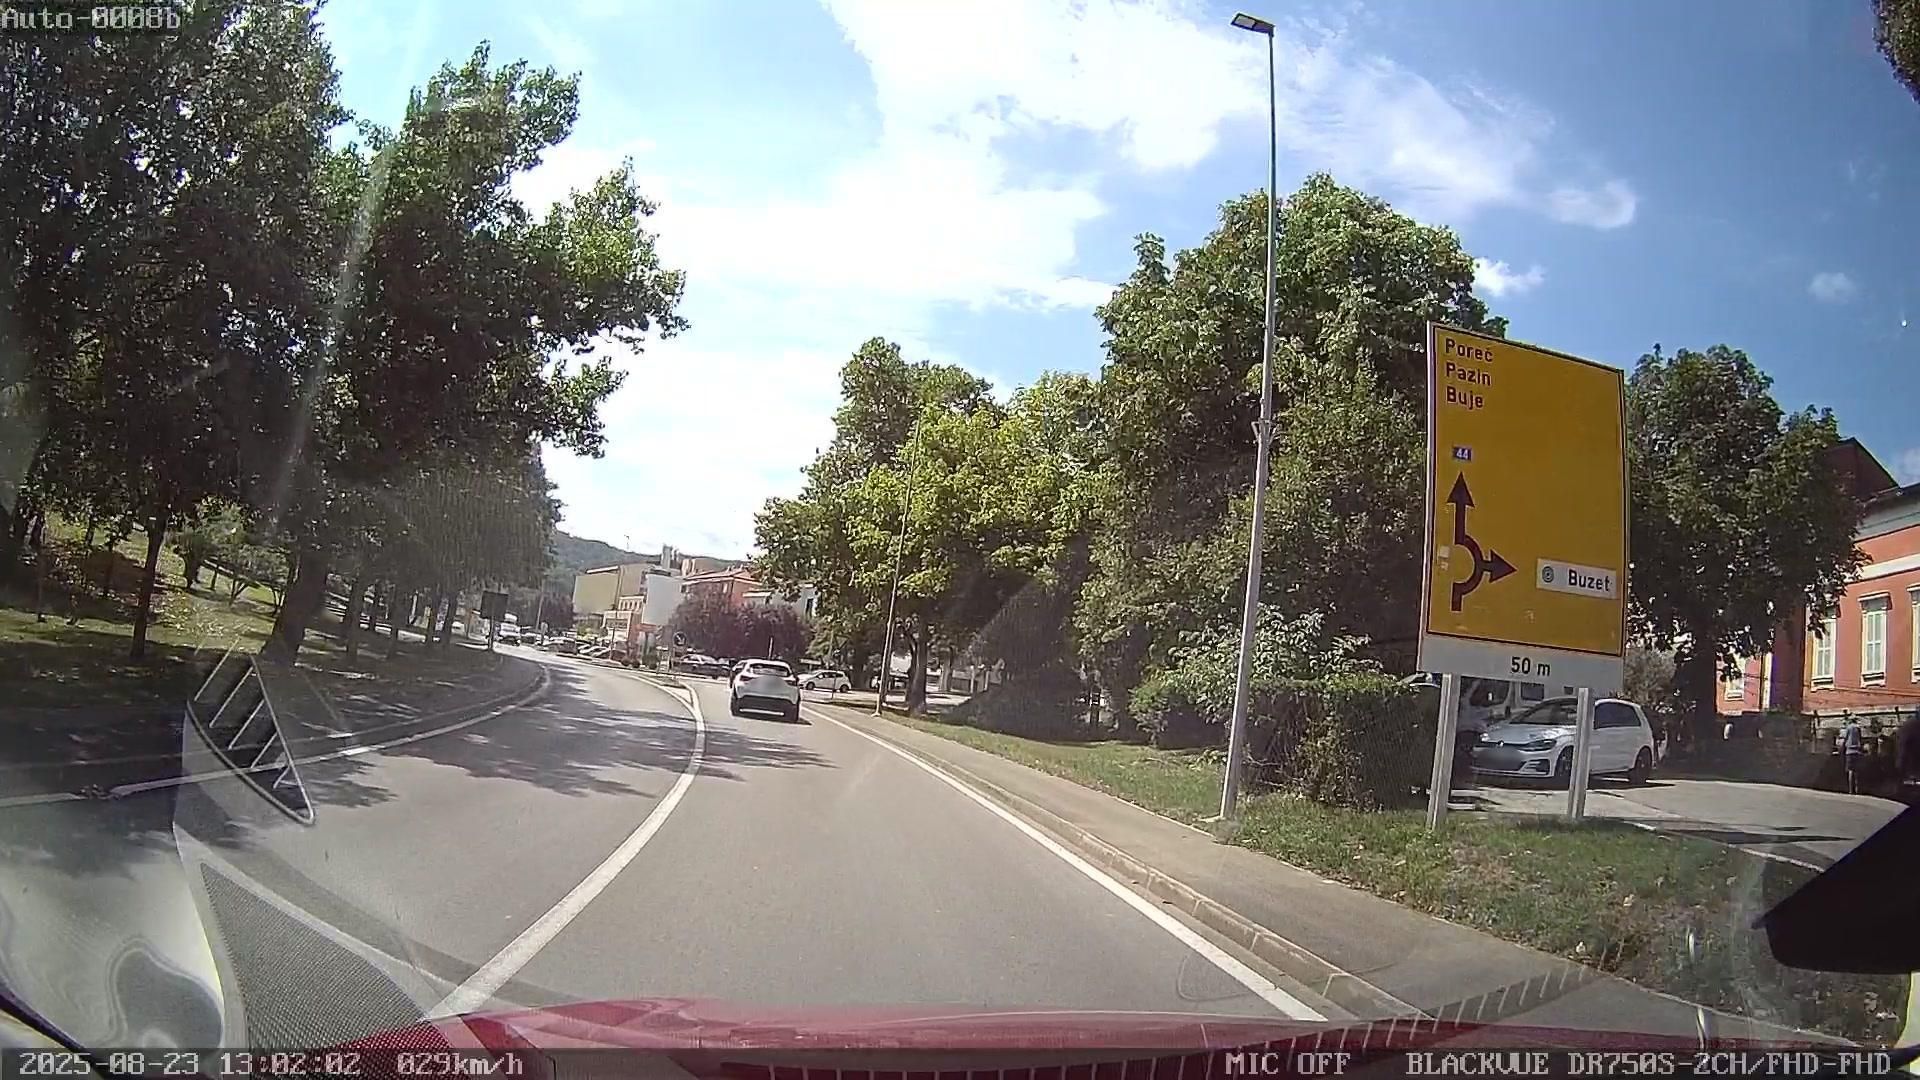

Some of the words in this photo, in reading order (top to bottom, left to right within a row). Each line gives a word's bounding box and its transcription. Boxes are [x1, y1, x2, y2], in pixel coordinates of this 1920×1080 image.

[1446, 362, 1491, 387] Pazin
[1446, 386, 1484, 410] Buje
[1455, 448, 1469, 460] 44
[1568, 569, 1611, 592] Buzet
[1511, 656, 1531, 675] 50
[1537, 663, 1551, 677] m
